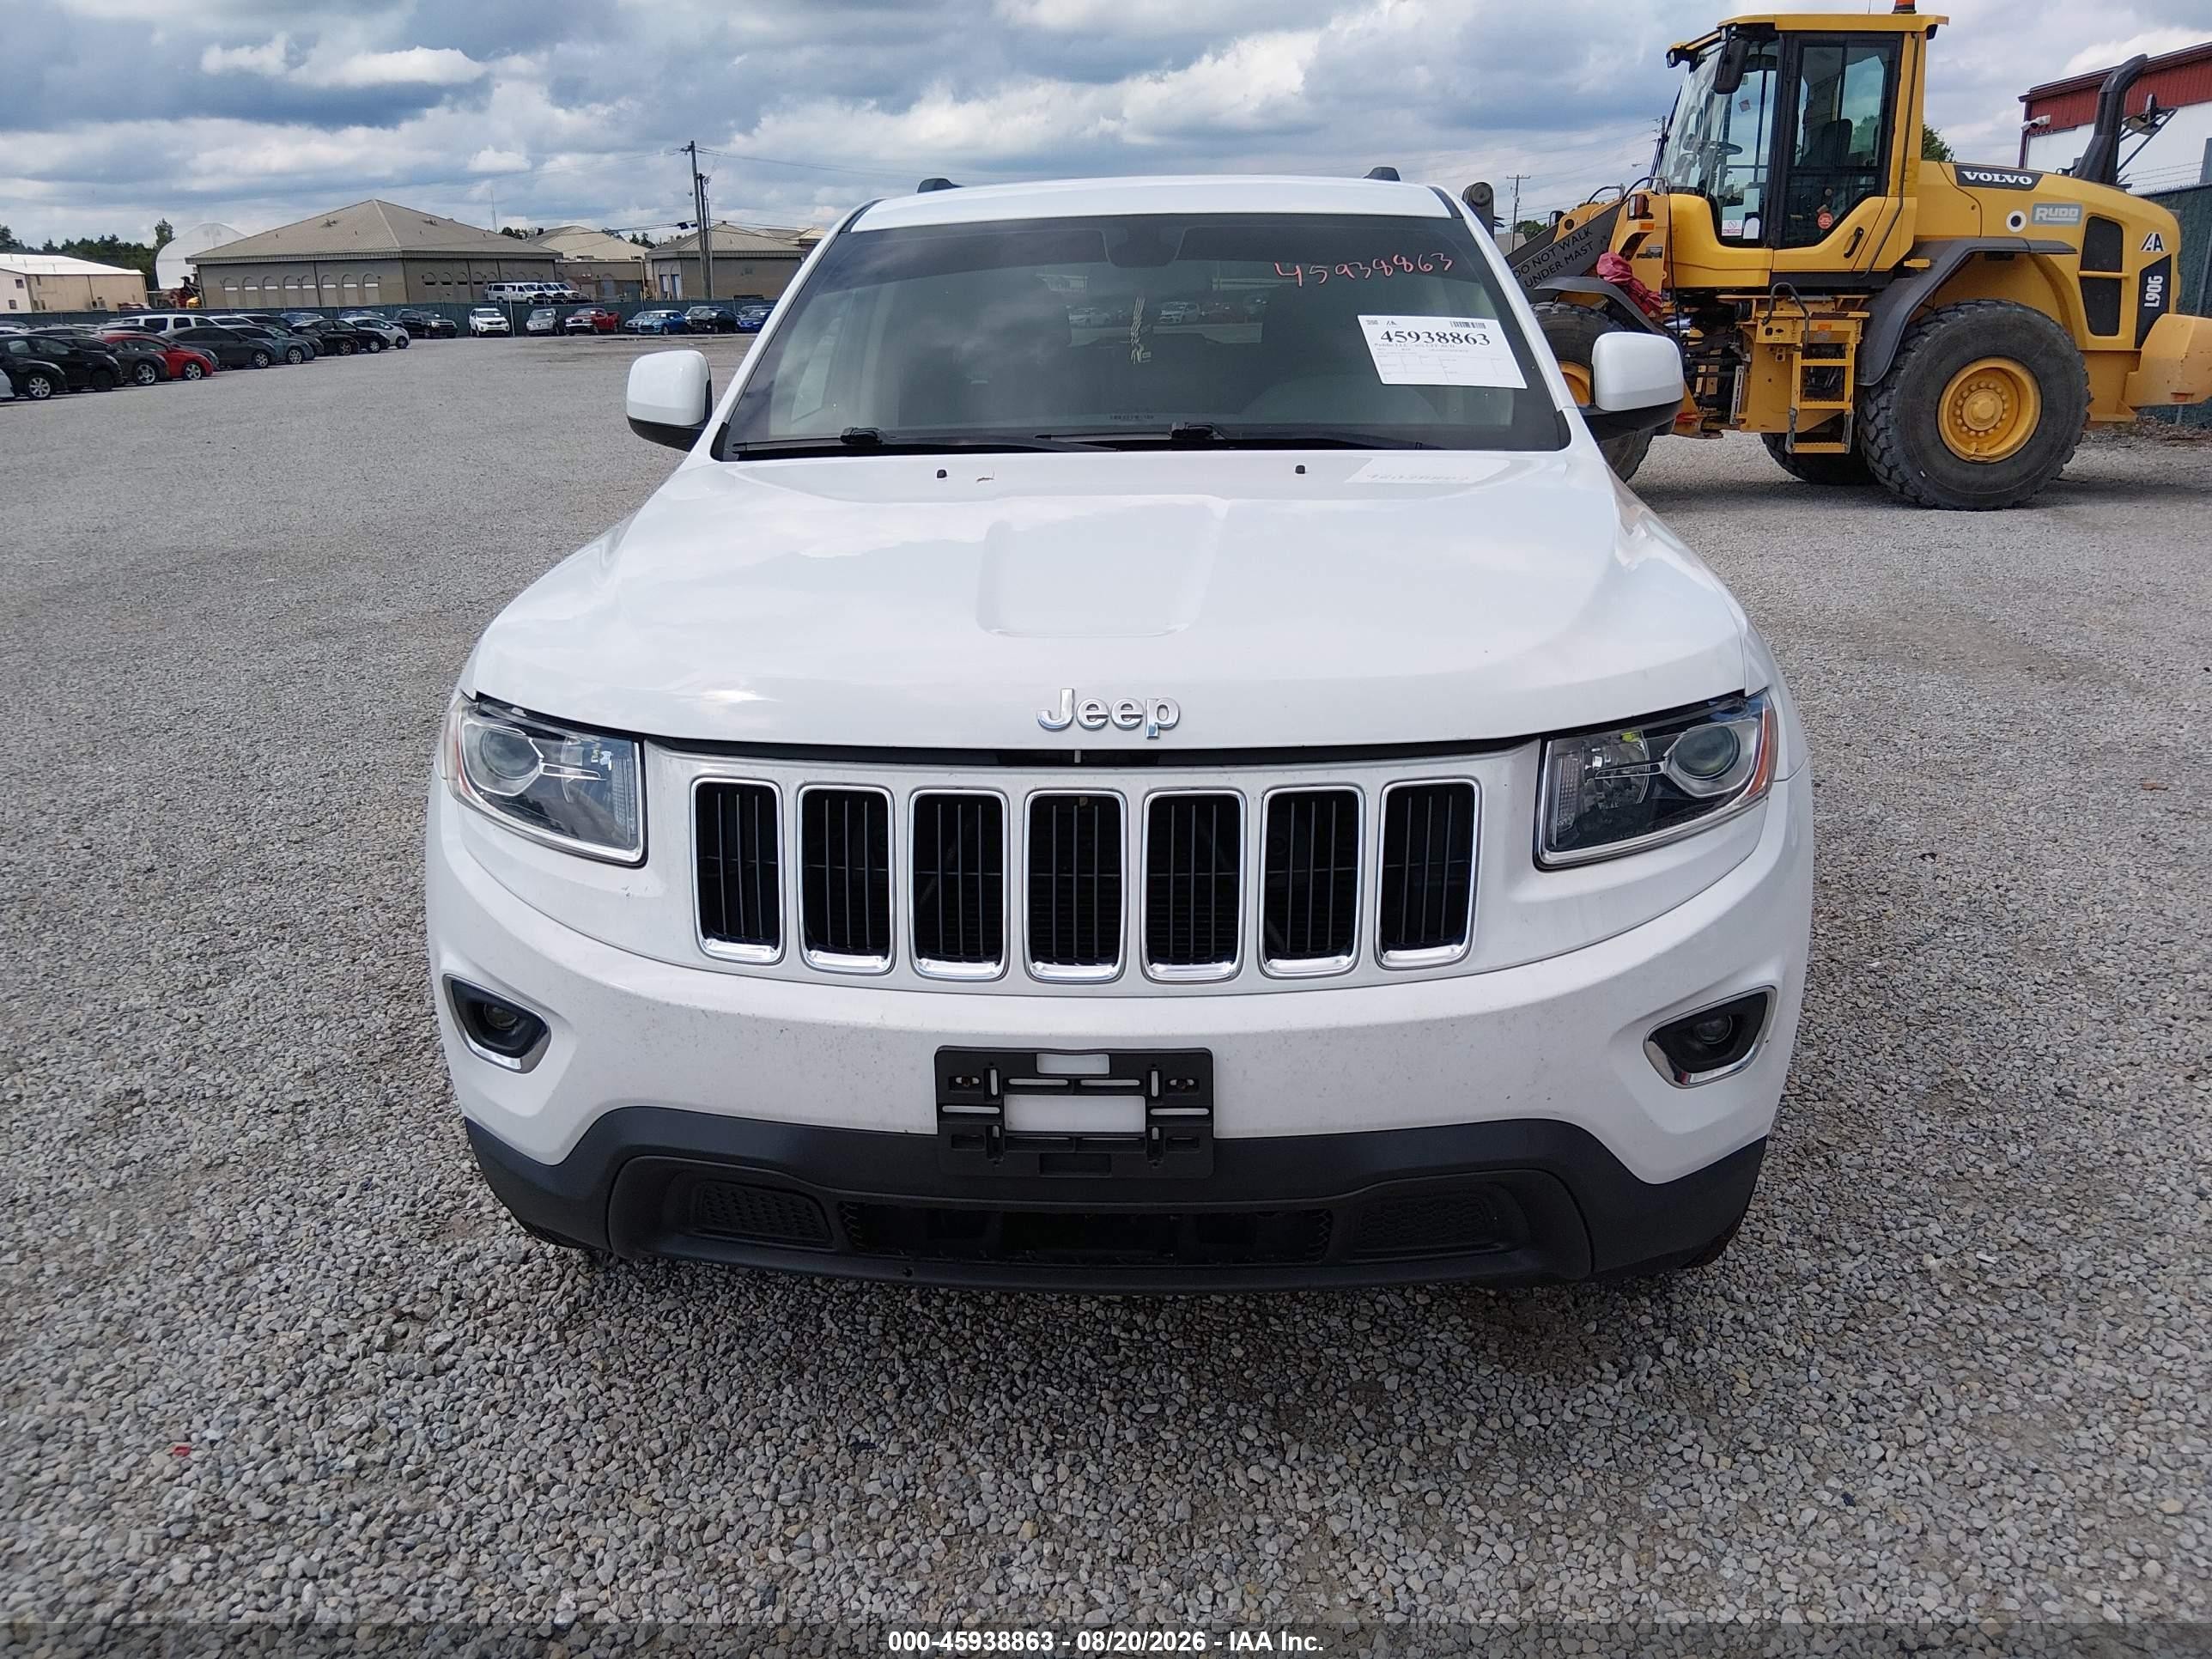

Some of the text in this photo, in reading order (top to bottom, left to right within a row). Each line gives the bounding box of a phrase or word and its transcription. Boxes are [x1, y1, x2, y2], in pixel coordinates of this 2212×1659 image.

[1960, 170, 2033, 185] VOLVO
[1274, 252, 1454, 287] 45938863
[1513, 227, 1593, 279] DO NOT WALK
[1524, 241, 1594, 288] UNDER MAST
[2144, 275, 2164, 307] L90G
[1380, 330, 1491, 346] 45938863
[1036, 687, 1181, 739] Jeep
